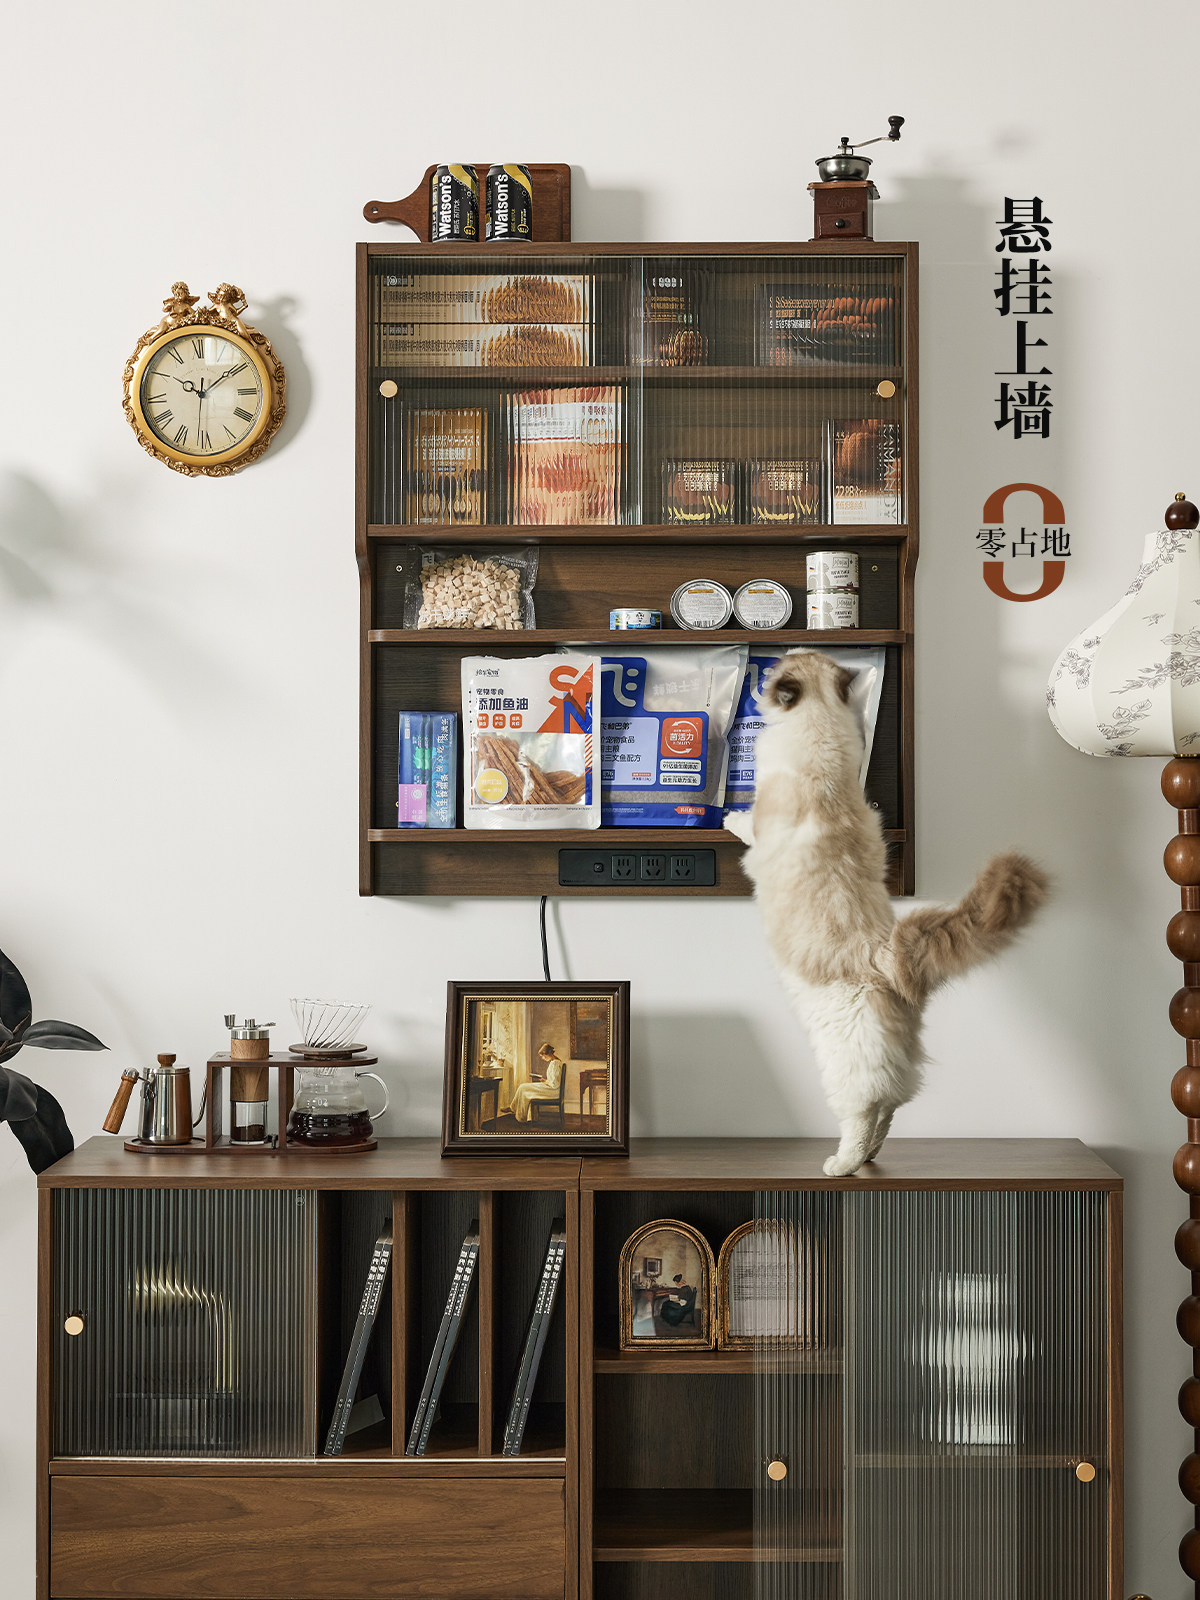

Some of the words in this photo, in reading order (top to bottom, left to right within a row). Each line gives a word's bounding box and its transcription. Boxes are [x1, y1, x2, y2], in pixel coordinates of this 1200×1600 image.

[438, 175, 452, 237] Watson's
[494, 174, 509, 236] Watson's
[476, 697, 529, 711] 添加鱼油
